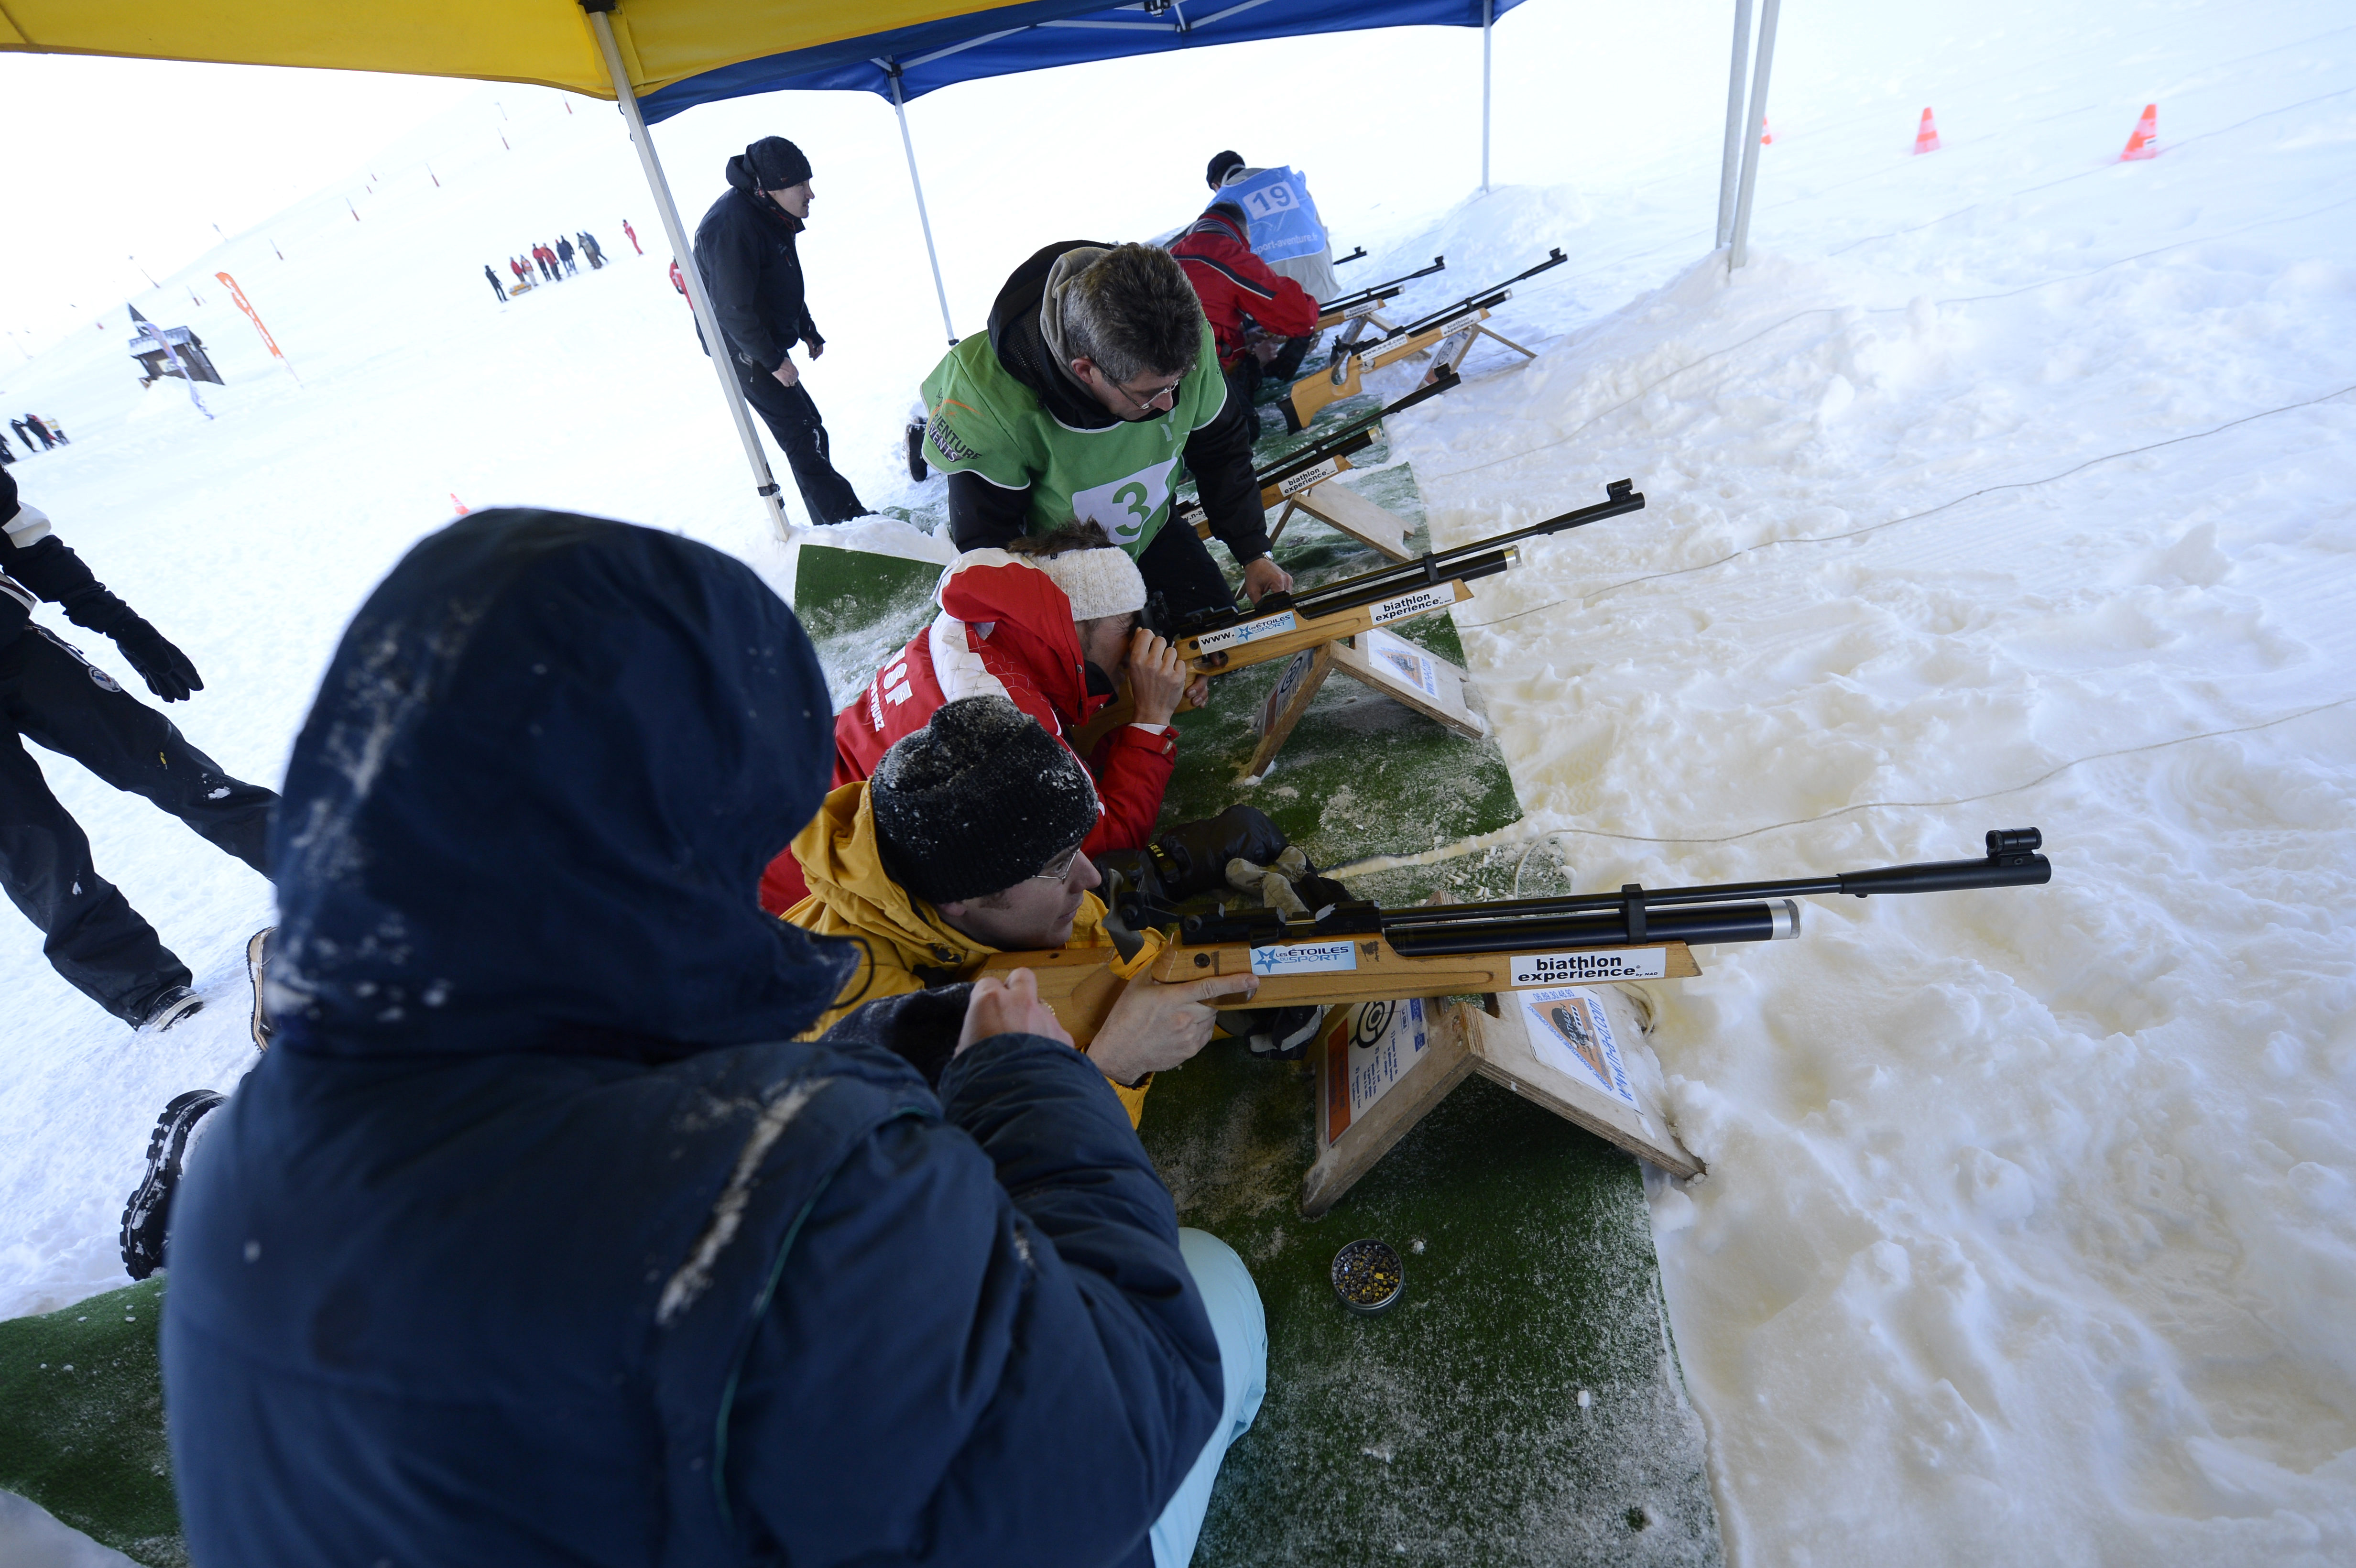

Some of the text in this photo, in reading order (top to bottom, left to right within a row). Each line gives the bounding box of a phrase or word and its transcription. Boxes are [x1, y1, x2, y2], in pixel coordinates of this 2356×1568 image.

[1253, 185, 1291, 211] 19
[1253, 232, 1318, 255] sport-aventure.fr
[1346, 307, 1372, 317] experience
[1349, 304, 1368, 313] biathlon
[1444, 318, 1474, 335] experience
[1447, 316, 1470, 328] biathlon
[1362, 336, 1406, 358] www.n-a-d.com
[1284, 471, 1327, 494] experience
[1288, 468, 1320, 486] biathlon
[1113, 482, 1151, 536] 3
[1375, 599, 1439, 621] experience
[1384, 594, 1430, 612] biathlon
[1254, 621, 1286, 633] SPORT
[1256, 615, 1290, 629] ÉTOILES
[1201, 632, 1235, 645] www.
[1285, 954, 1340, 963] SPORT
[1288, 946, 1349, 957] ÉTOILES
[1536, 955, 1622, 971] biathlon
[1518, 968, 1636, 982] experience
[1533, 989, 1575, 1002] 06.89.30.48.93
[1527, 1006, 1563, 1041] DEVELOPMENT
[1563, 1040, 1594, 1071] ADVENTURE
[1593, 1070, 1613, 1091] NORDIC
